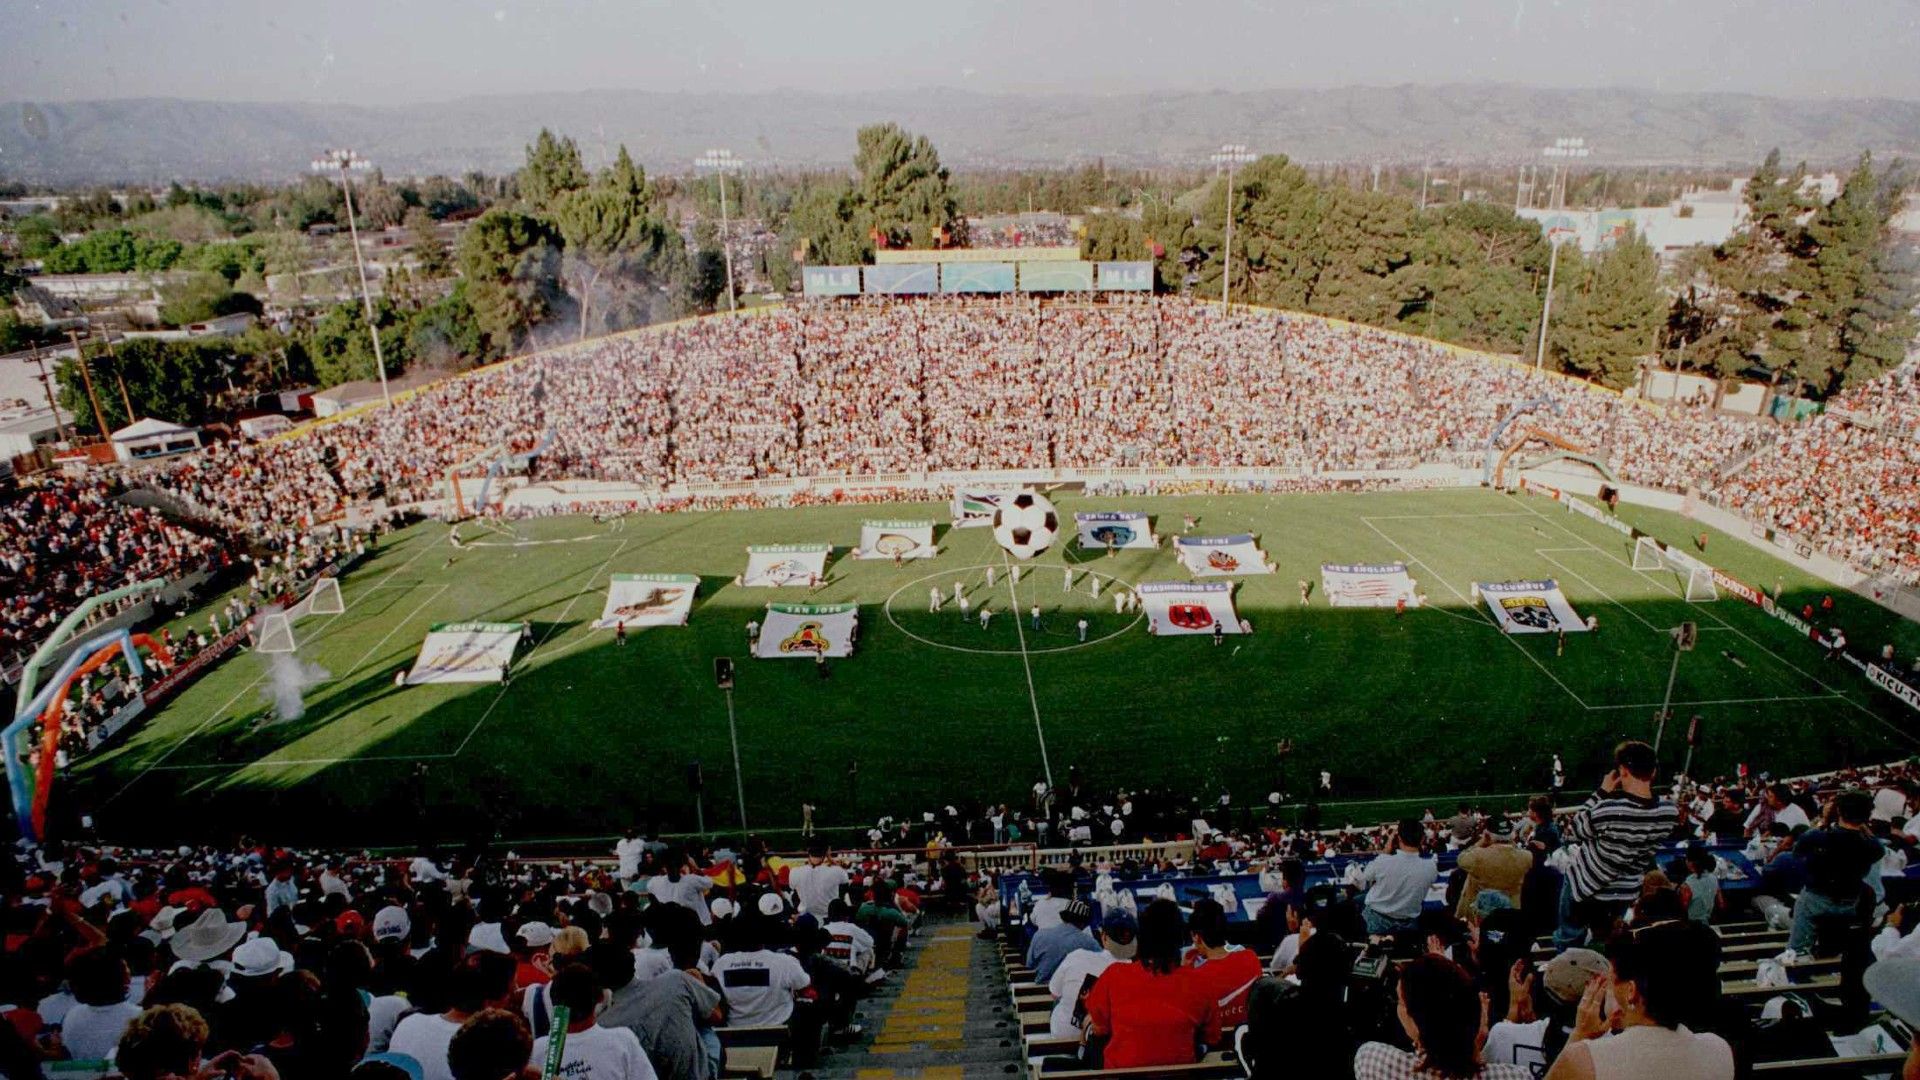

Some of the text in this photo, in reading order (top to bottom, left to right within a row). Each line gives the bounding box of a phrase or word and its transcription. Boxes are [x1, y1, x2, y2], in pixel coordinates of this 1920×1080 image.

[811, 272, 851, 286] MLS
[800, 544, 824, 552] CITY
[1353, 566, 1402, 574] ENGLAND
[633, 574, 677, 582] DALLAS
[1142, 583, 1204, 593] WASHINGTON
[1489, 583, 1545, 591] COLUMBUS
[1713, 570, 1758, 604] HONDA
[787, 605, 842, 614] SAN JOSE
[1776, 606, 1812, 637] FUJIFILM
[445, 622, 511, 632] COLORADO
